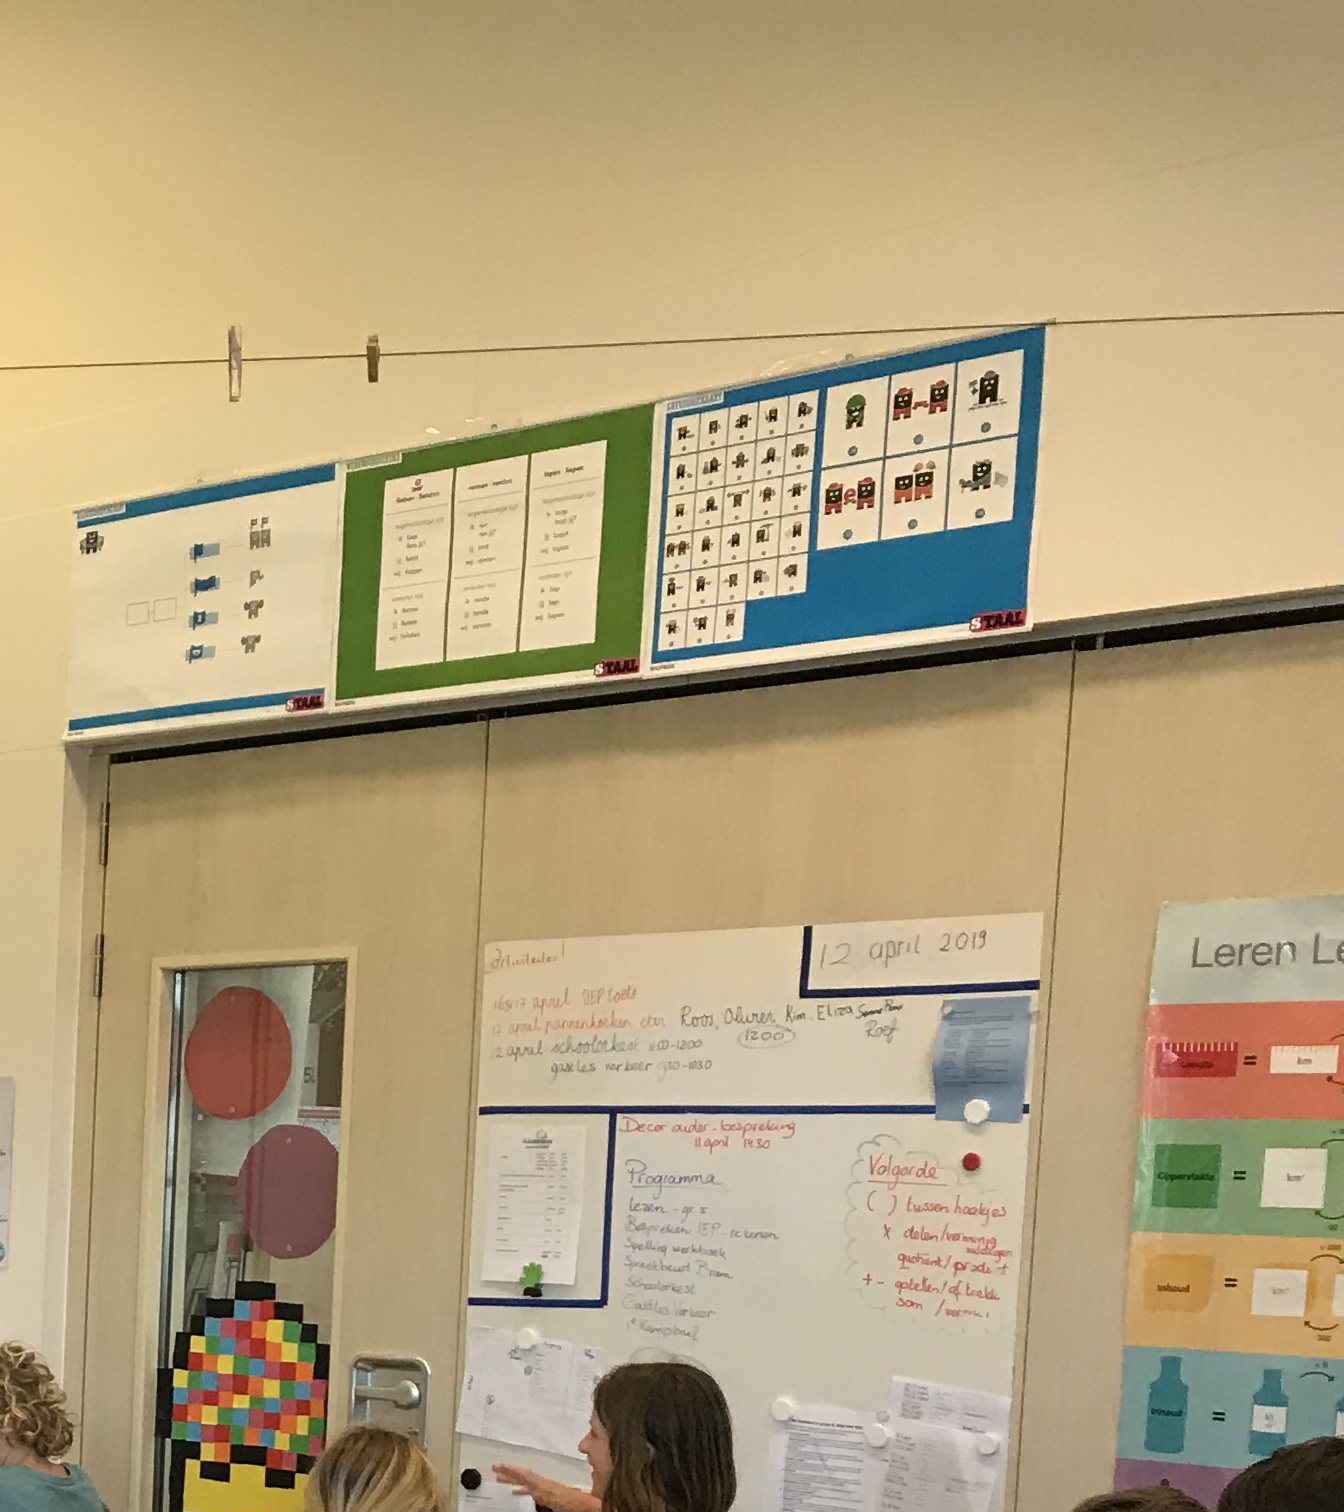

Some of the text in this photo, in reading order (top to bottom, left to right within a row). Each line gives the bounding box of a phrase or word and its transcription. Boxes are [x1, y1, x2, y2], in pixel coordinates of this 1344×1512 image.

[969, 610, 1025, 632] STAAL
[594, 658, 639, 677] STAAL
[819, 929, 988, 970] 12 april 2019
[1191, 936, 1297, 968] Leren
[619, 1116, 665, 1134] Decor
[624, 1158, 724, 1200] Programma
[869, 1152, 940, 1191] Volgorde
[906, 1195, 950, 1214] tussen
[953, 1194, 1007, 1228] haakjes
